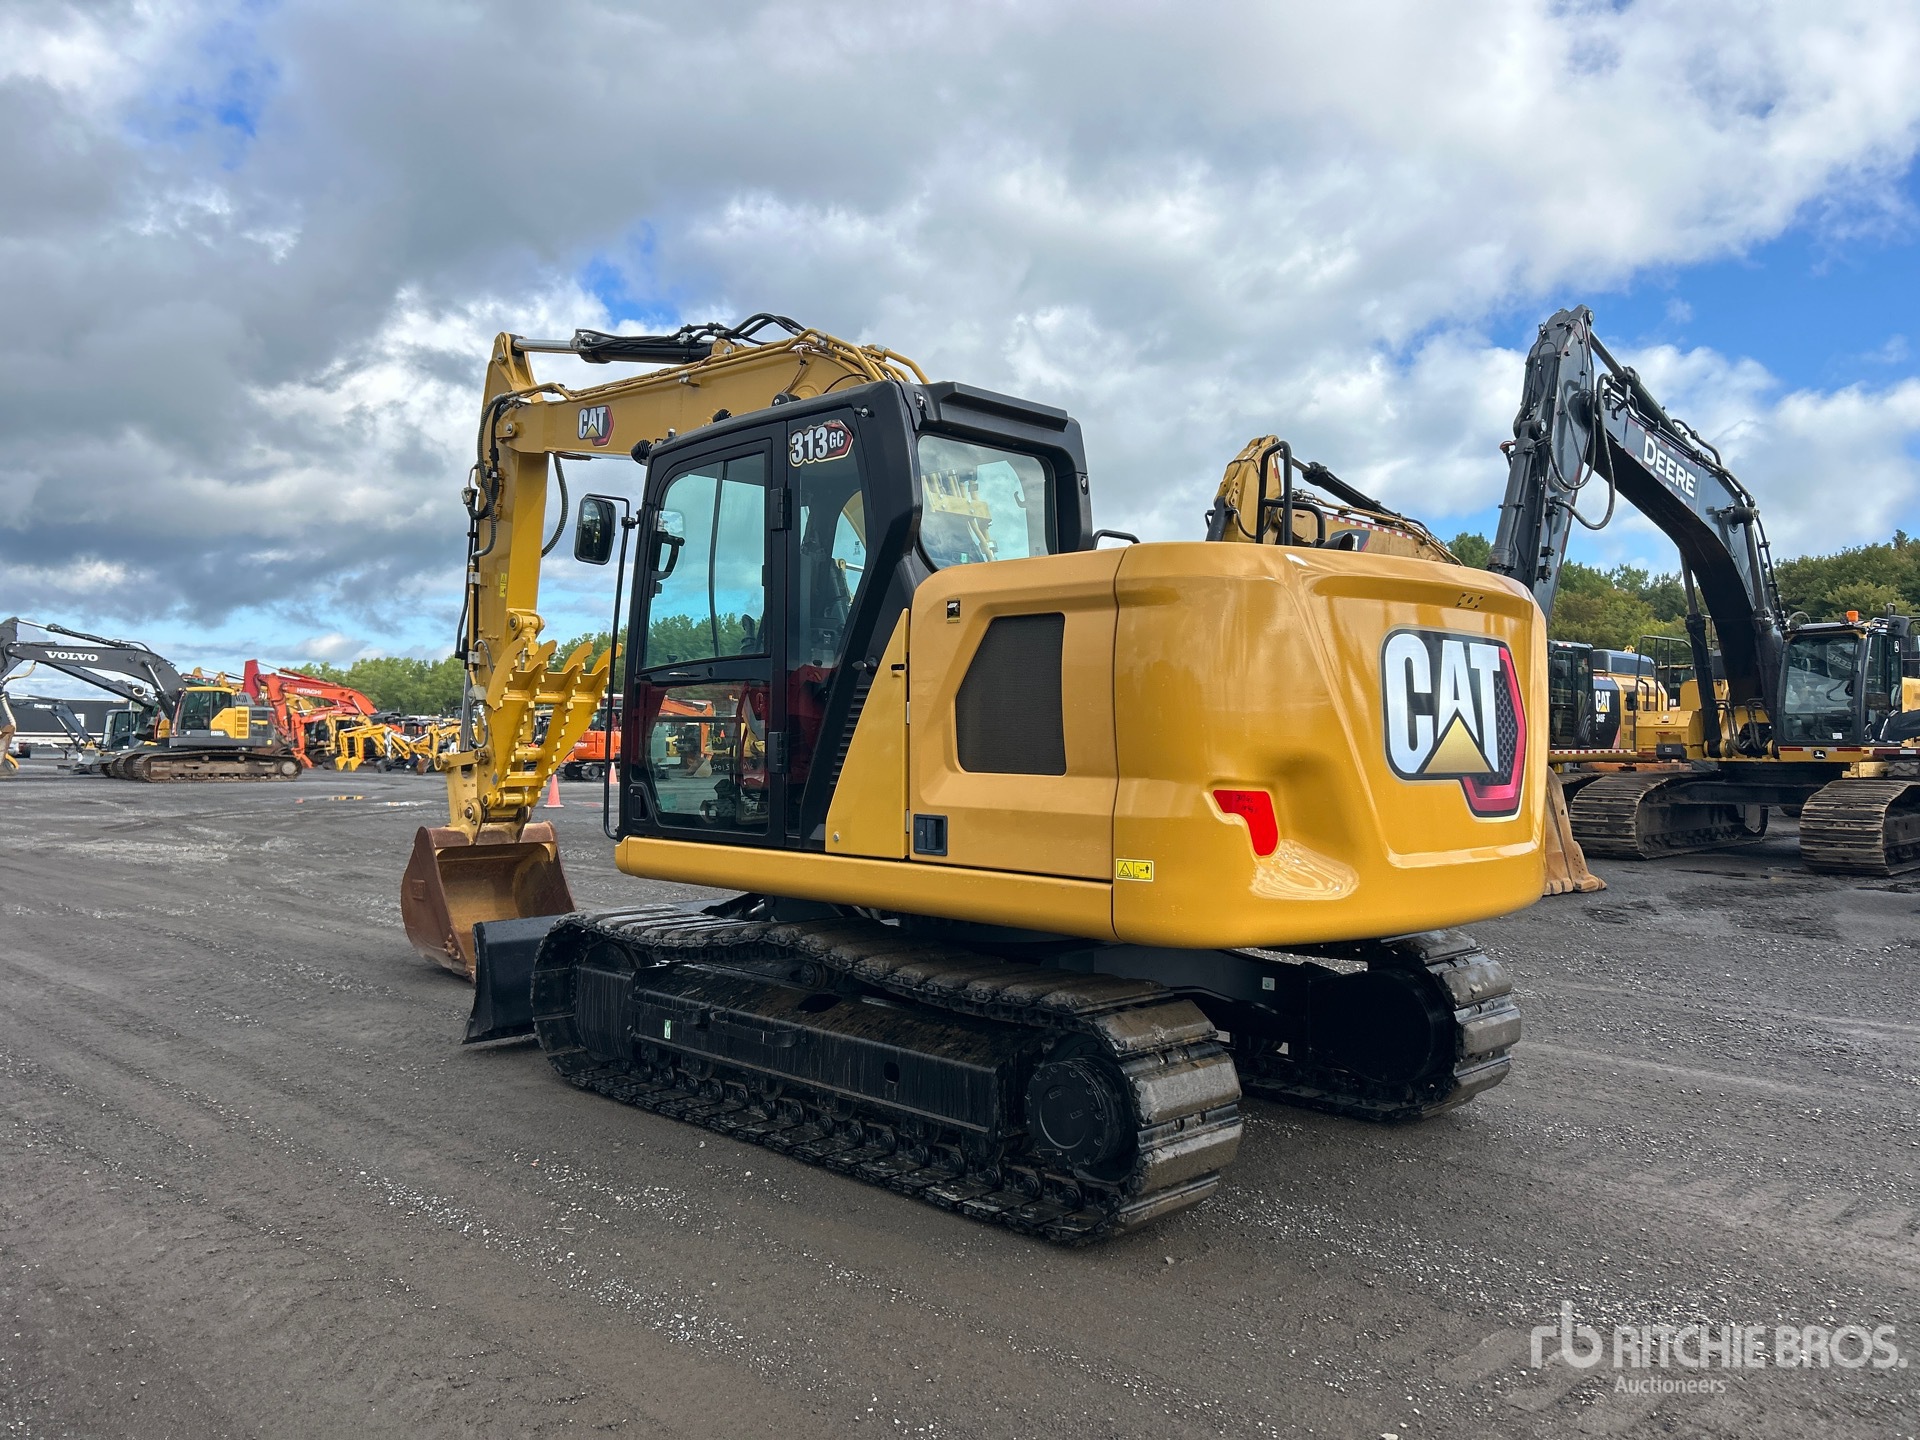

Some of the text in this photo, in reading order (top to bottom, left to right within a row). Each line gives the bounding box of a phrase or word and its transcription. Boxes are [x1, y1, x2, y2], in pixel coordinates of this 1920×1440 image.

[578, 406, 606, 439] CAT
[791, 427, 844, 463] 313 GC
[1643, 434, 1696, 498] DEERE
[44, 650, 99, 662] VOLVO
[296, 687, 323, 695] HITACHI
[1384, 633, 1501, 774] CAT
[1595, 690, 1611, 712] CAT
